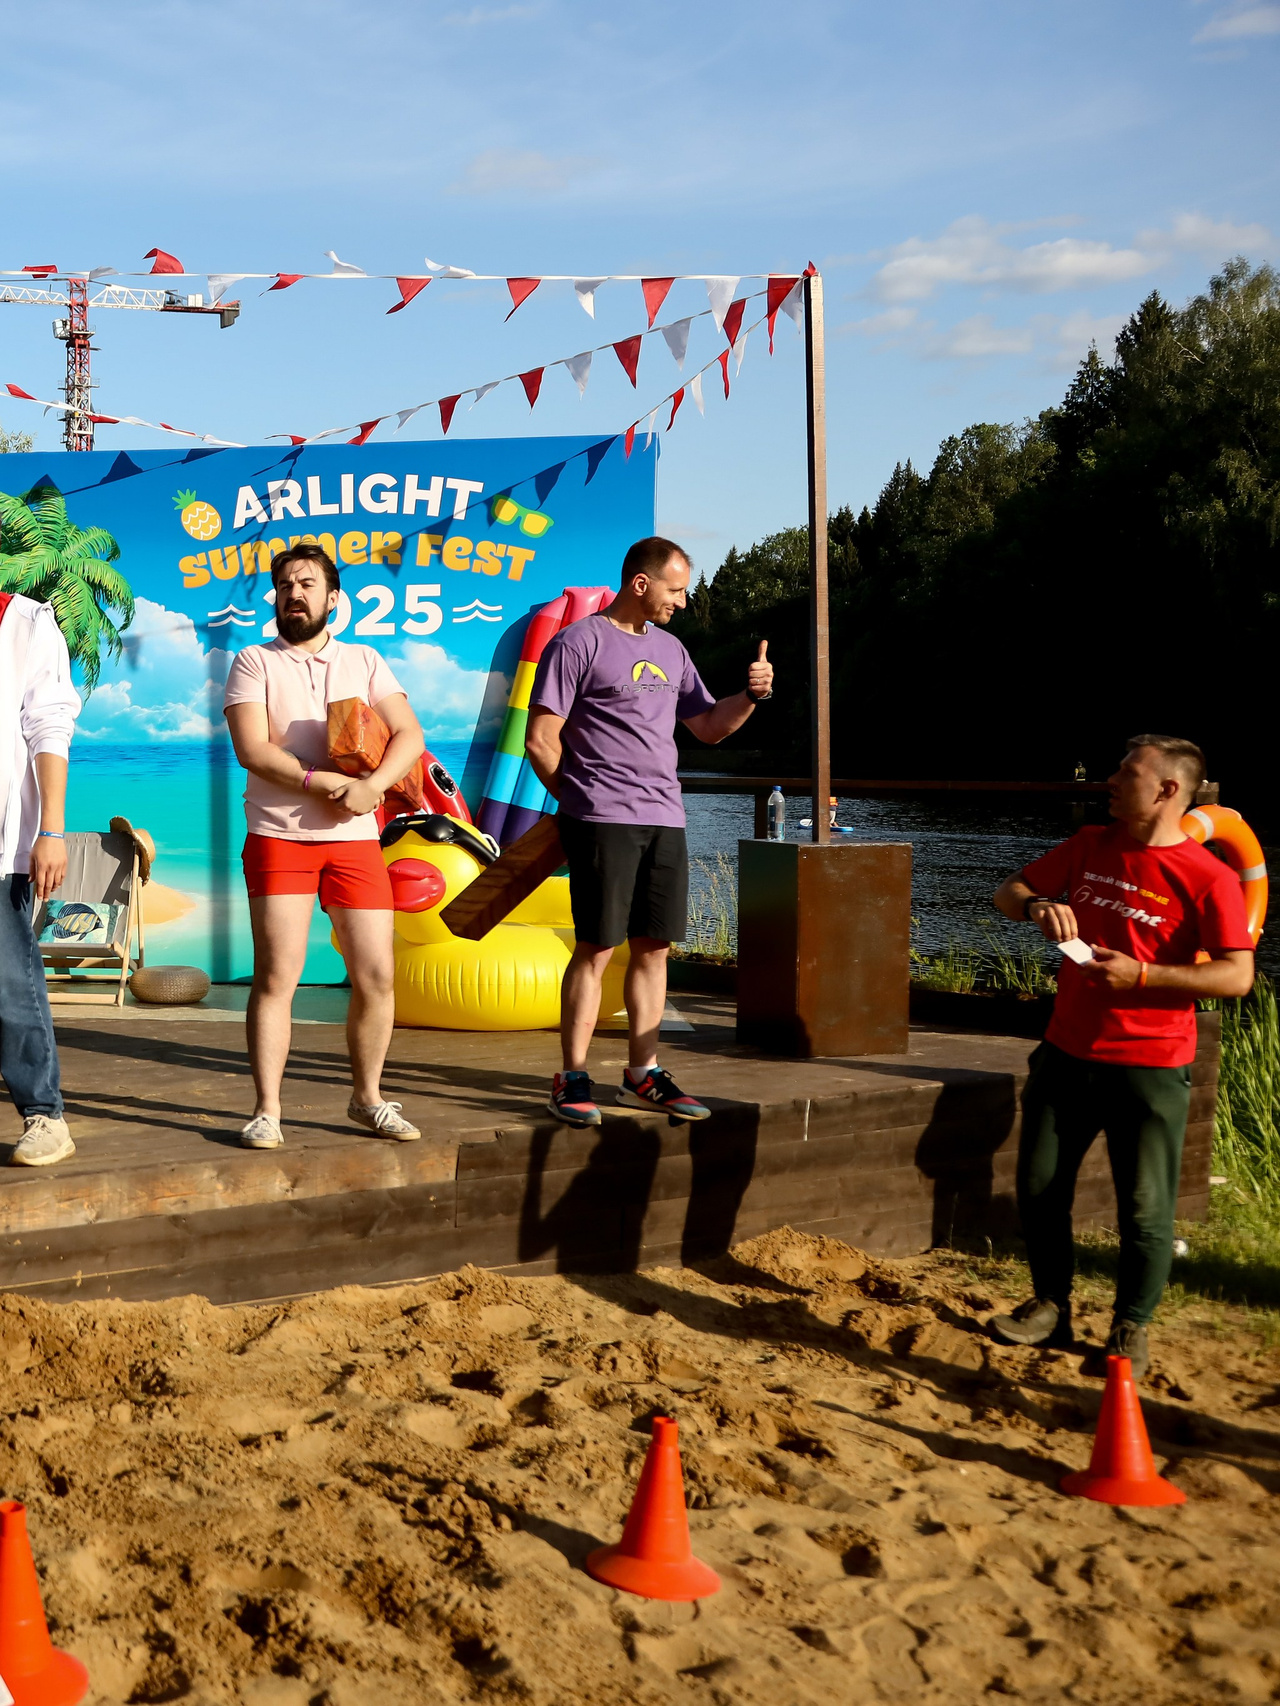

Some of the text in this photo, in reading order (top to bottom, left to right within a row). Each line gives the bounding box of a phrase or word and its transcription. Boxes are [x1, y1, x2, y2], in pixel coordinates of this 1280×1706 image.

[233, 473, 484, 529] ARLIGHT
[262, 583, 443, 638] 25
[613, 684, 630, 694] LA
